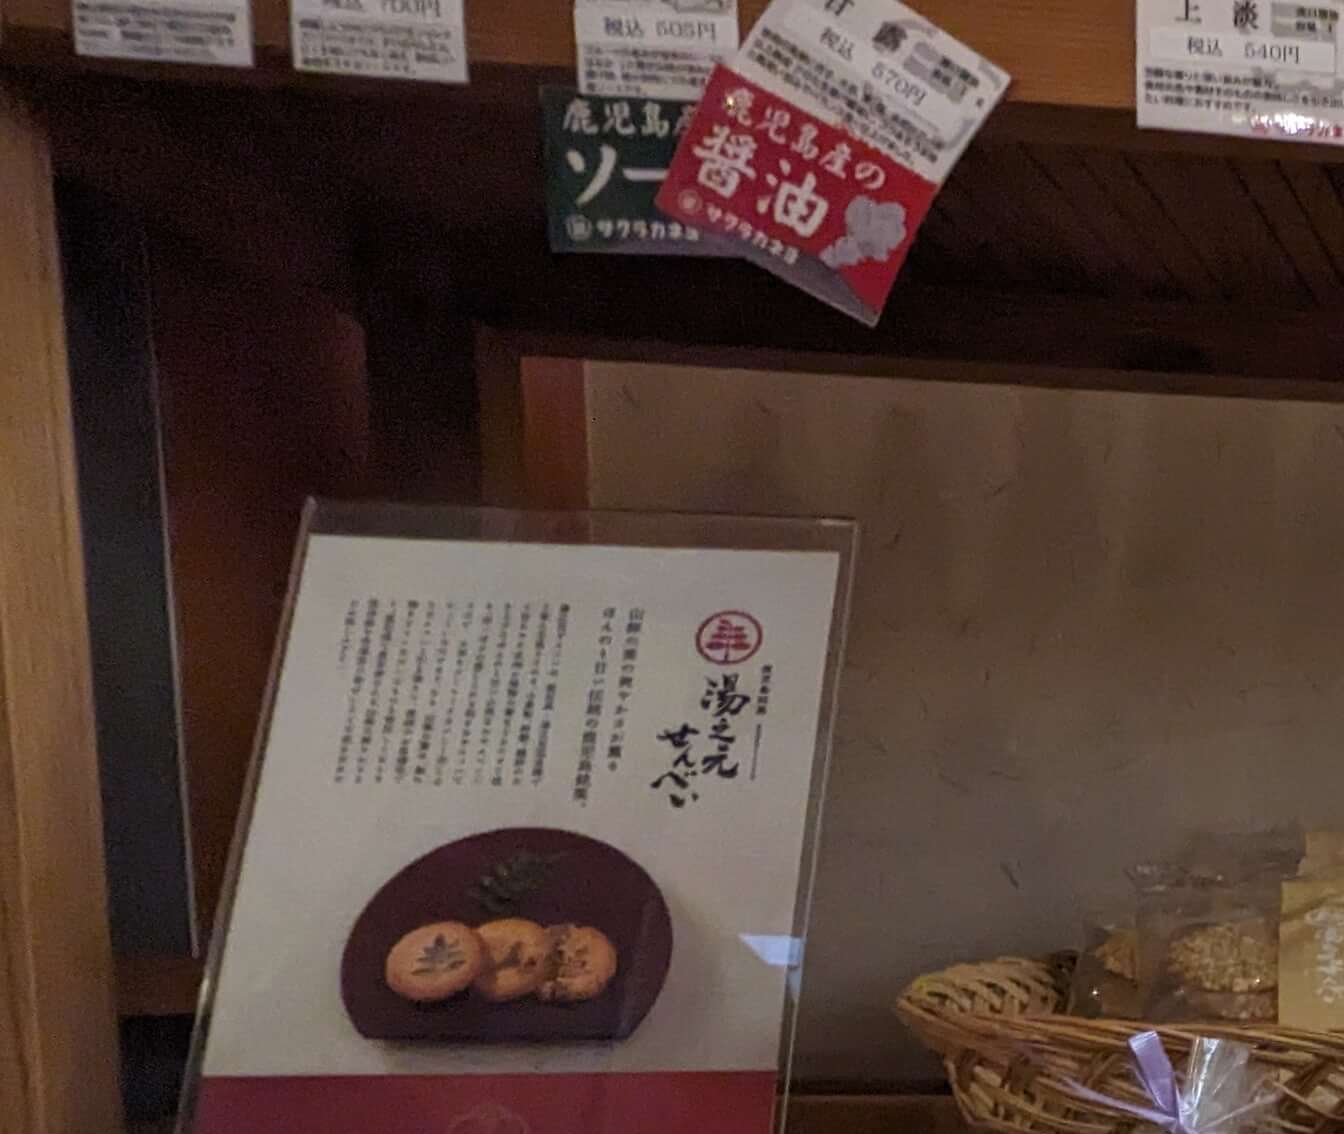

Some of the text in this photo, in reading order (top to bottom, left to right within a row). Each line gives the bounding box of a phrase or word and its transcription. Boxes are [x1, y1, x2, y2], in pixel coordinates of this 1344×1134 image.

[1187, 35, 1224, 58] 税込
[565, 146, 667, 206] ソー
[693, 124, 830, 241] 醤油
[650, 722, 701, 809] せんべい
[700, 672, 752, 779] 湯之元
